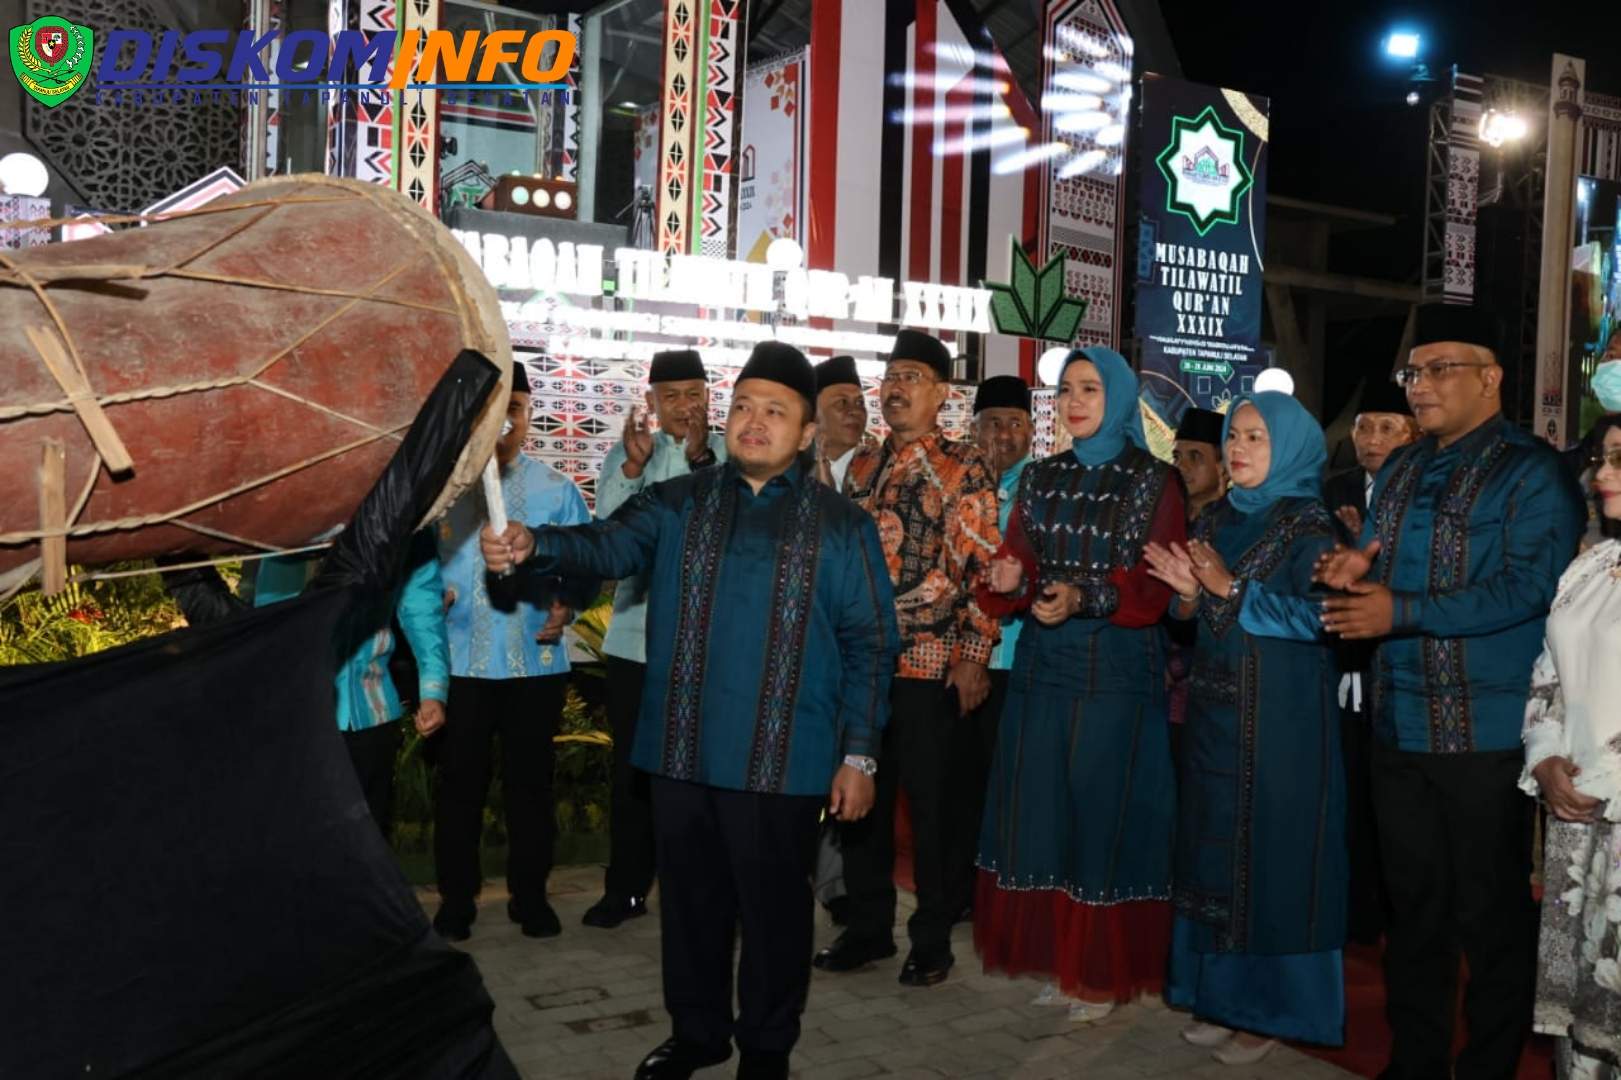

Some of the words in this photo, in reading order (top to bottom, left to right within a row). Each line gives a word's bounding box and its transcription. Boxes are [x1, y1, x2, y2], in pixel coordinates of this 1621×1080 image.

[1155, 243, 1249, 274] MUSABAQAH
[1160, 266, 1243, 295] TILAWATIL
[1173, 290, 1230, 316] QUR'AN
[1176, 313, 1224, 337] XXXIX
